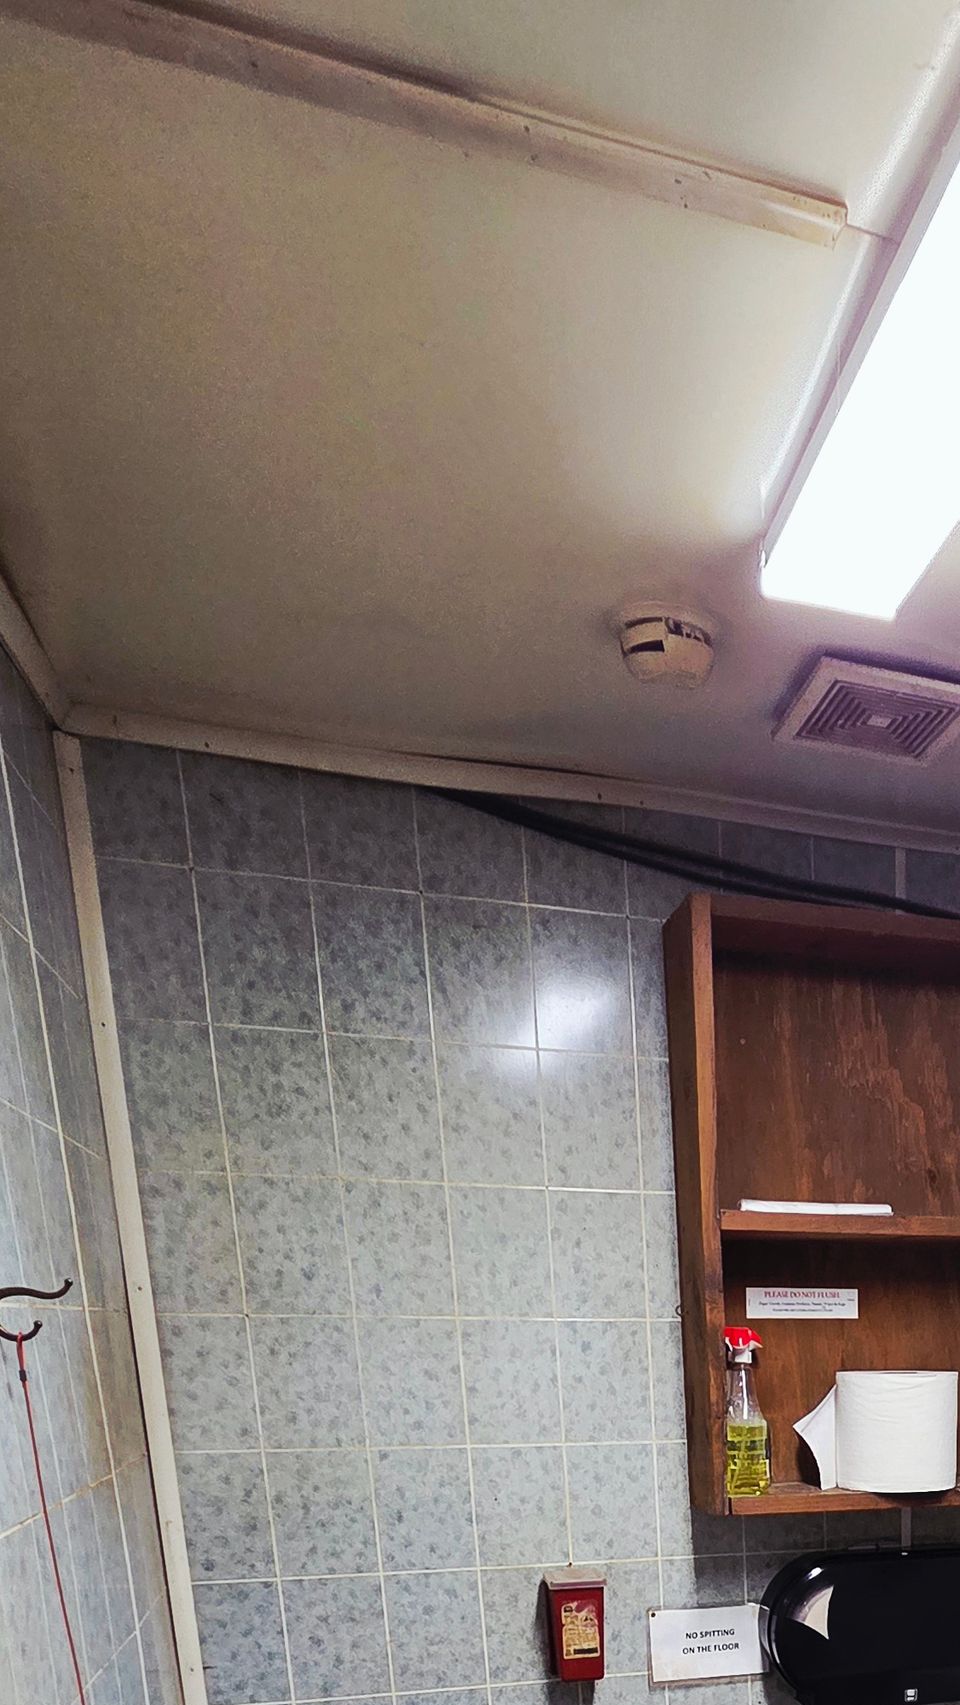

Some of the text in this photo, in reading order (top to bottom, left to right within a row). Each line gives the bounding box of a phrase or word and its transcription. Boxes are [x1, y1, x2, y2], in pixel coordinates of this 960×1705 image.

[764, 1291, 788, 1299] PLEASE
[790, 1291, 801, 1299] DO
[801, 1291, 816, 1299] NOT
[699, 1628, 735, 1638] SPITTING
[697, 1645, 712, 1653] THE
[714, 1642, 739, 1651] FLOOR
